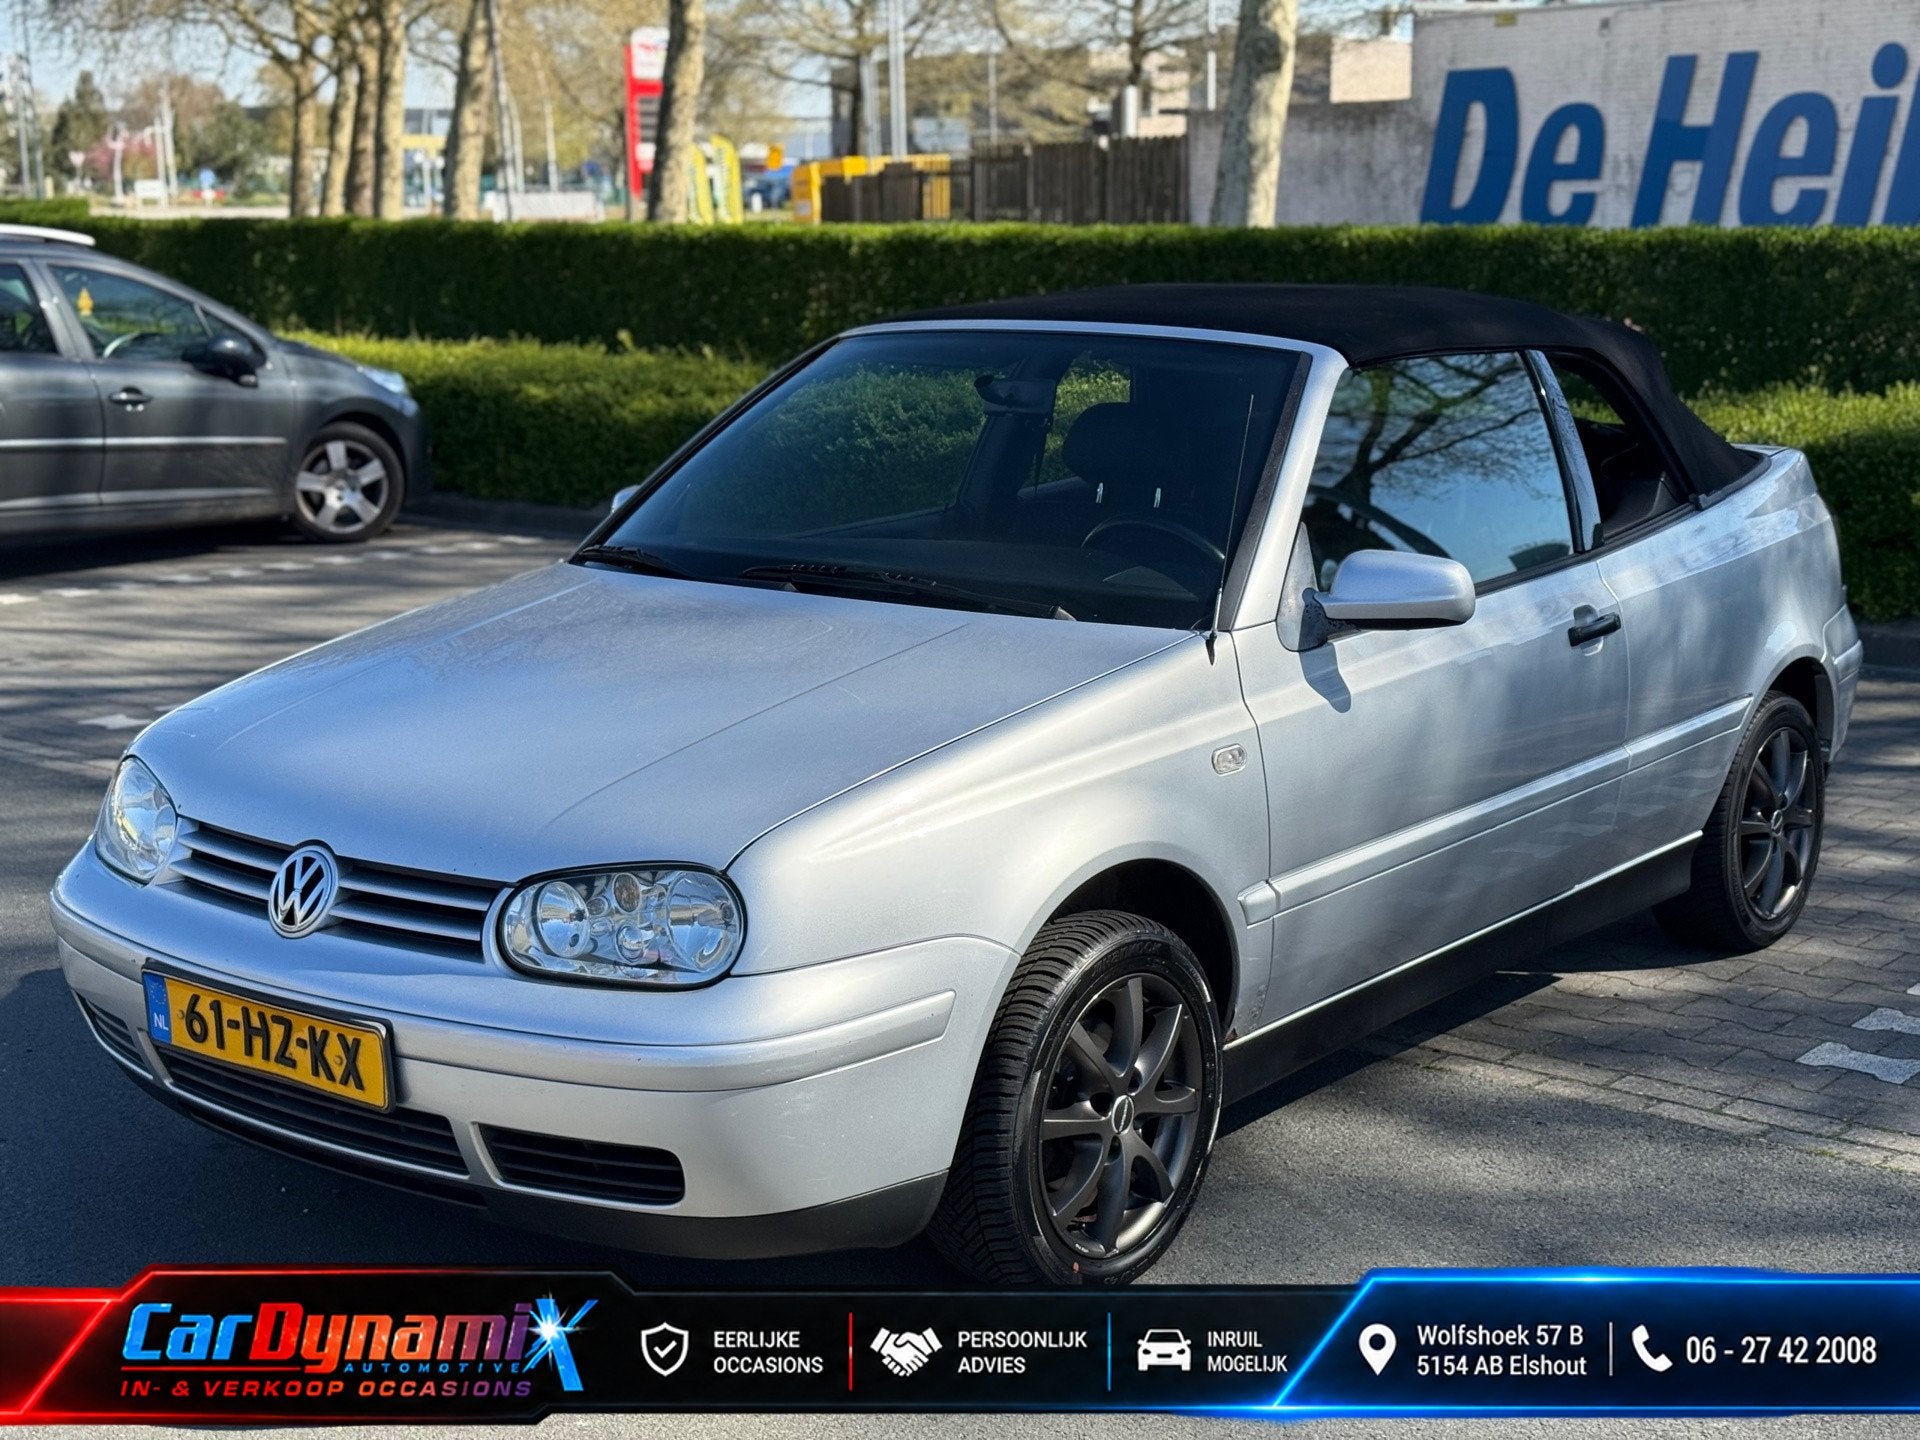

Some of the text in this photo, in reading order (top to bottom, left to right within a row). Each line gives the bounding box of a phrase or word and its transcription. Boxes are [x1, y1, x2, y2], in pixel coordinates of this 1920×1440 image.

[1420, 66, 1607, 226] De
[153, 1012, 169, 1031] NL
[185, 993, 366, 1091] 61-HZ-KX
